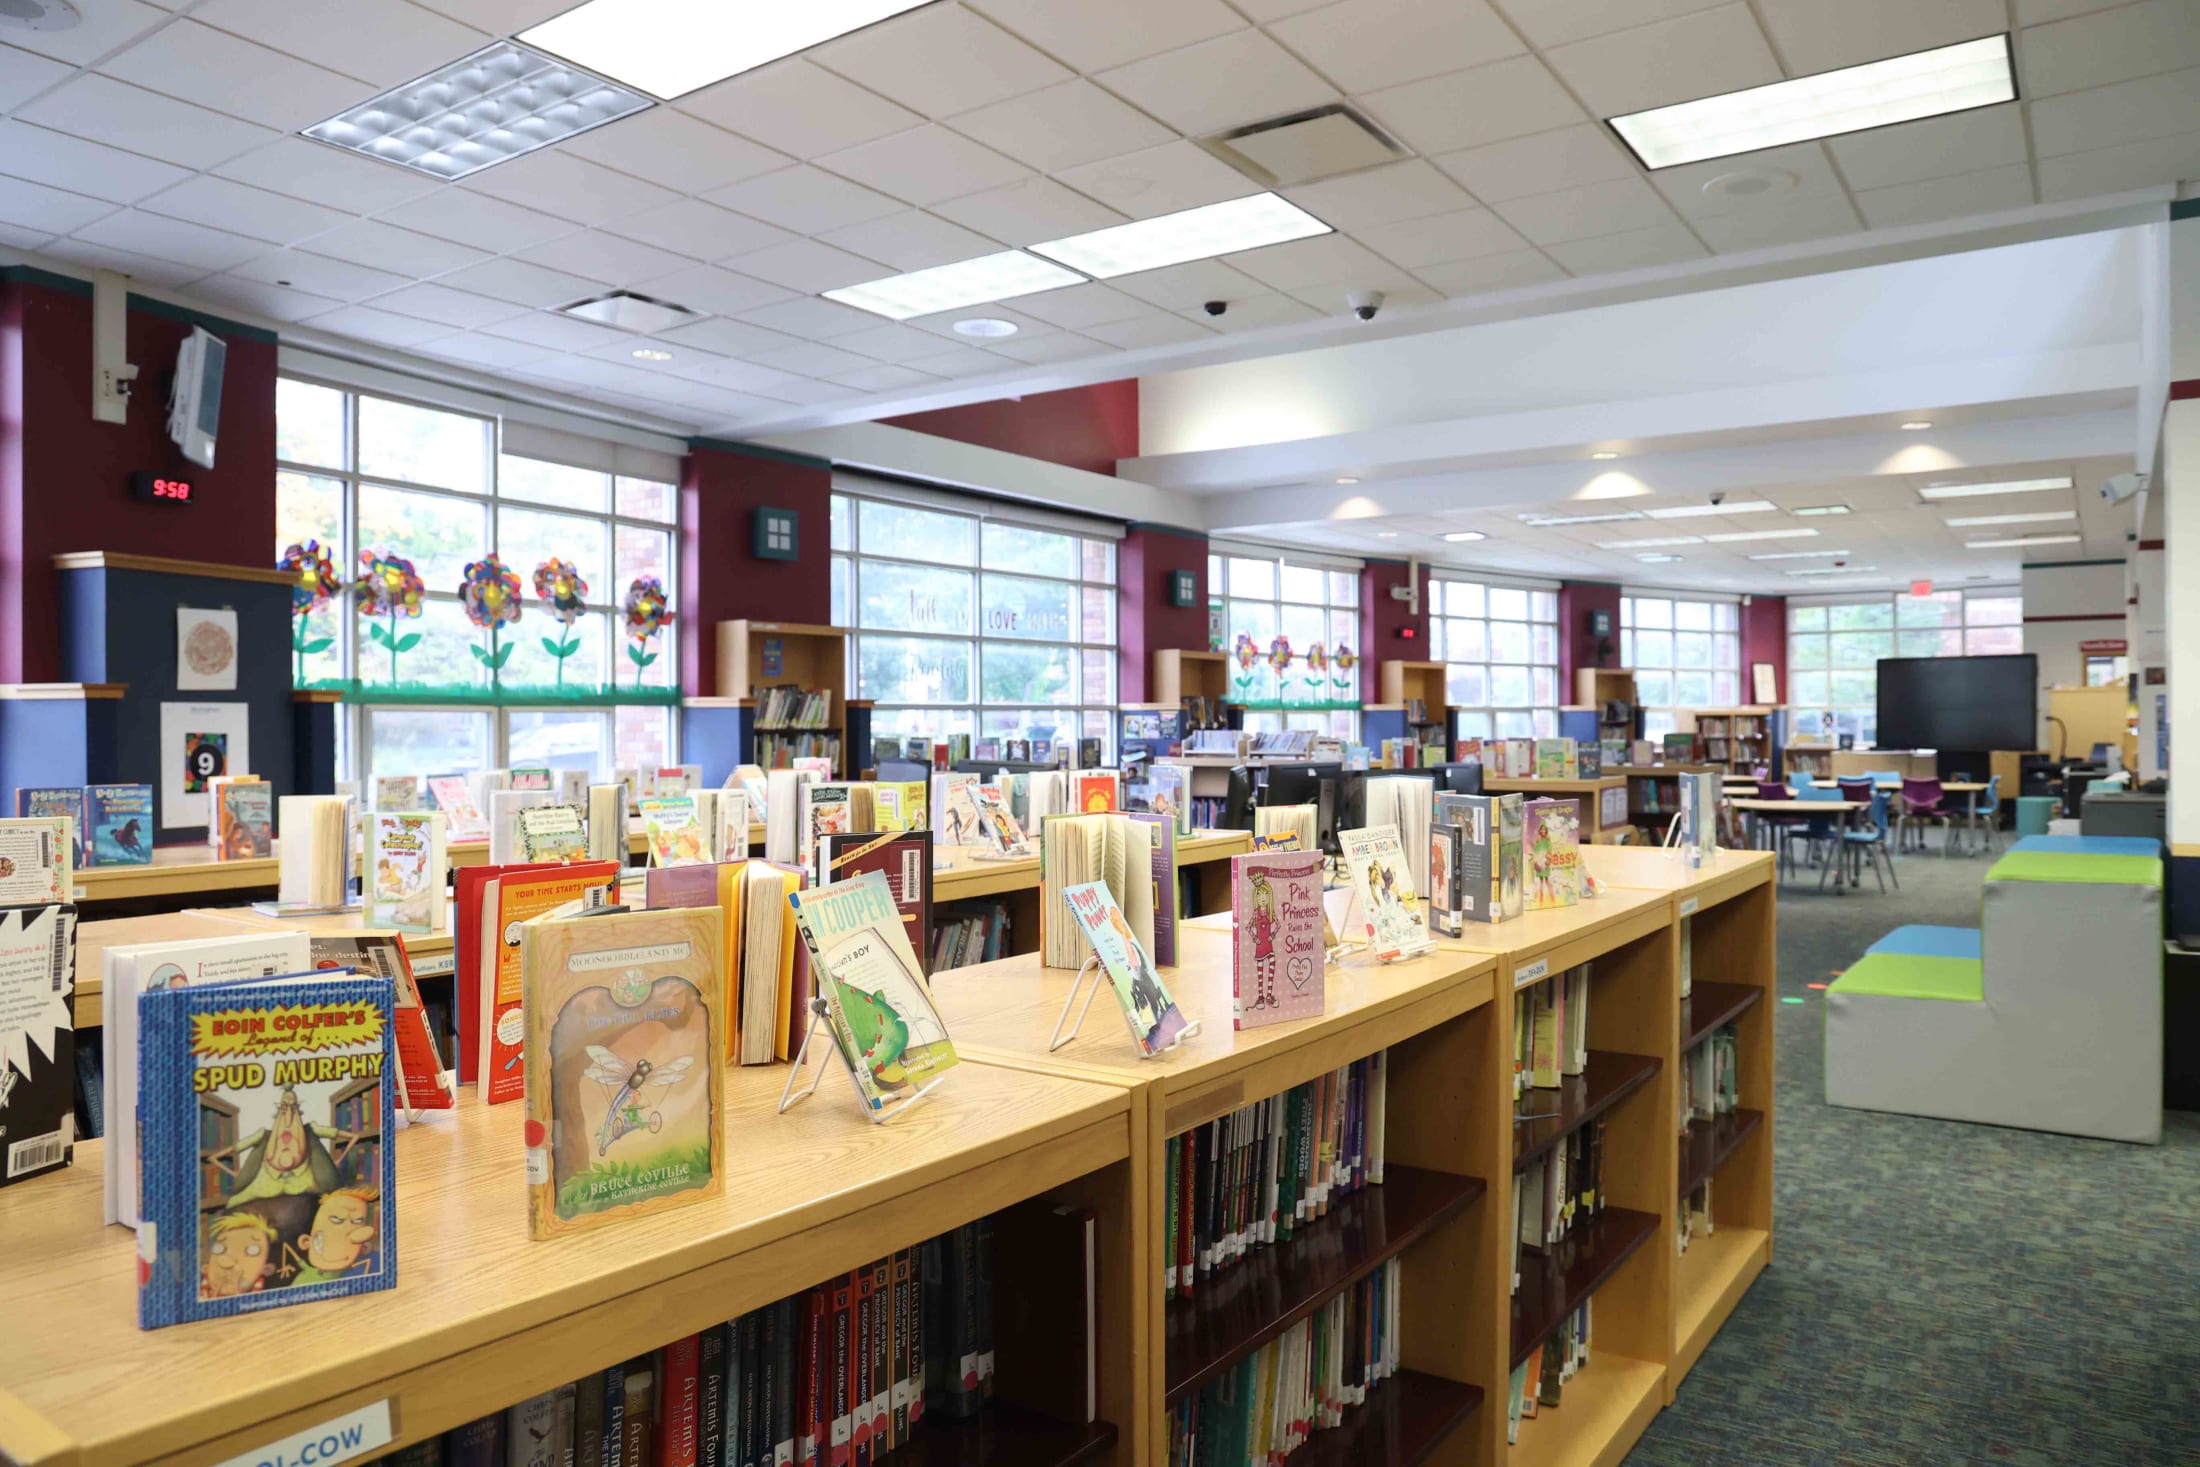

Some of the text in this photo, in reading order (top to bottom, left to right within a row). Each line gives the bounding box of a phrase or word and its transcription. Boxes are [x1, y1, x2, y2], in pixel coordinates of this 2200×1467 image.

[153, 479, 190, 499] 9:58
[988, 611, 1018, 631] LOVE
[198, 753, 215, 775] 9
[1545, 852, 1577, 868] Sassy
[515, 890, 534, 900] YOUR
[537, 887, 554, 896] TIME
[556, 883, 581, 895] STARTS
[1288, 882, 1311, 901] Pink
[823, 886, 891, 935] COOPER
[1281, 902, 1319, 921] Princess
[1304, 922, 1313, 930] the
[646, 948, 670, 958] AND
[853, 944, 871, 959] BOY
[1285, 935, 1314, 954] School
[212, 1010, 367, 1037] EOIN COLFER'S
[243, 1034, 298, 1048] Legend
[193, 1052, 386, 1093] SPUD MURPHY
[590, 1163, 690, 1196] BRUCE COVILLE
[611, 1183, 658, 1200] KATHERINE
[838, 1314, 846, 1347] GREGOR
